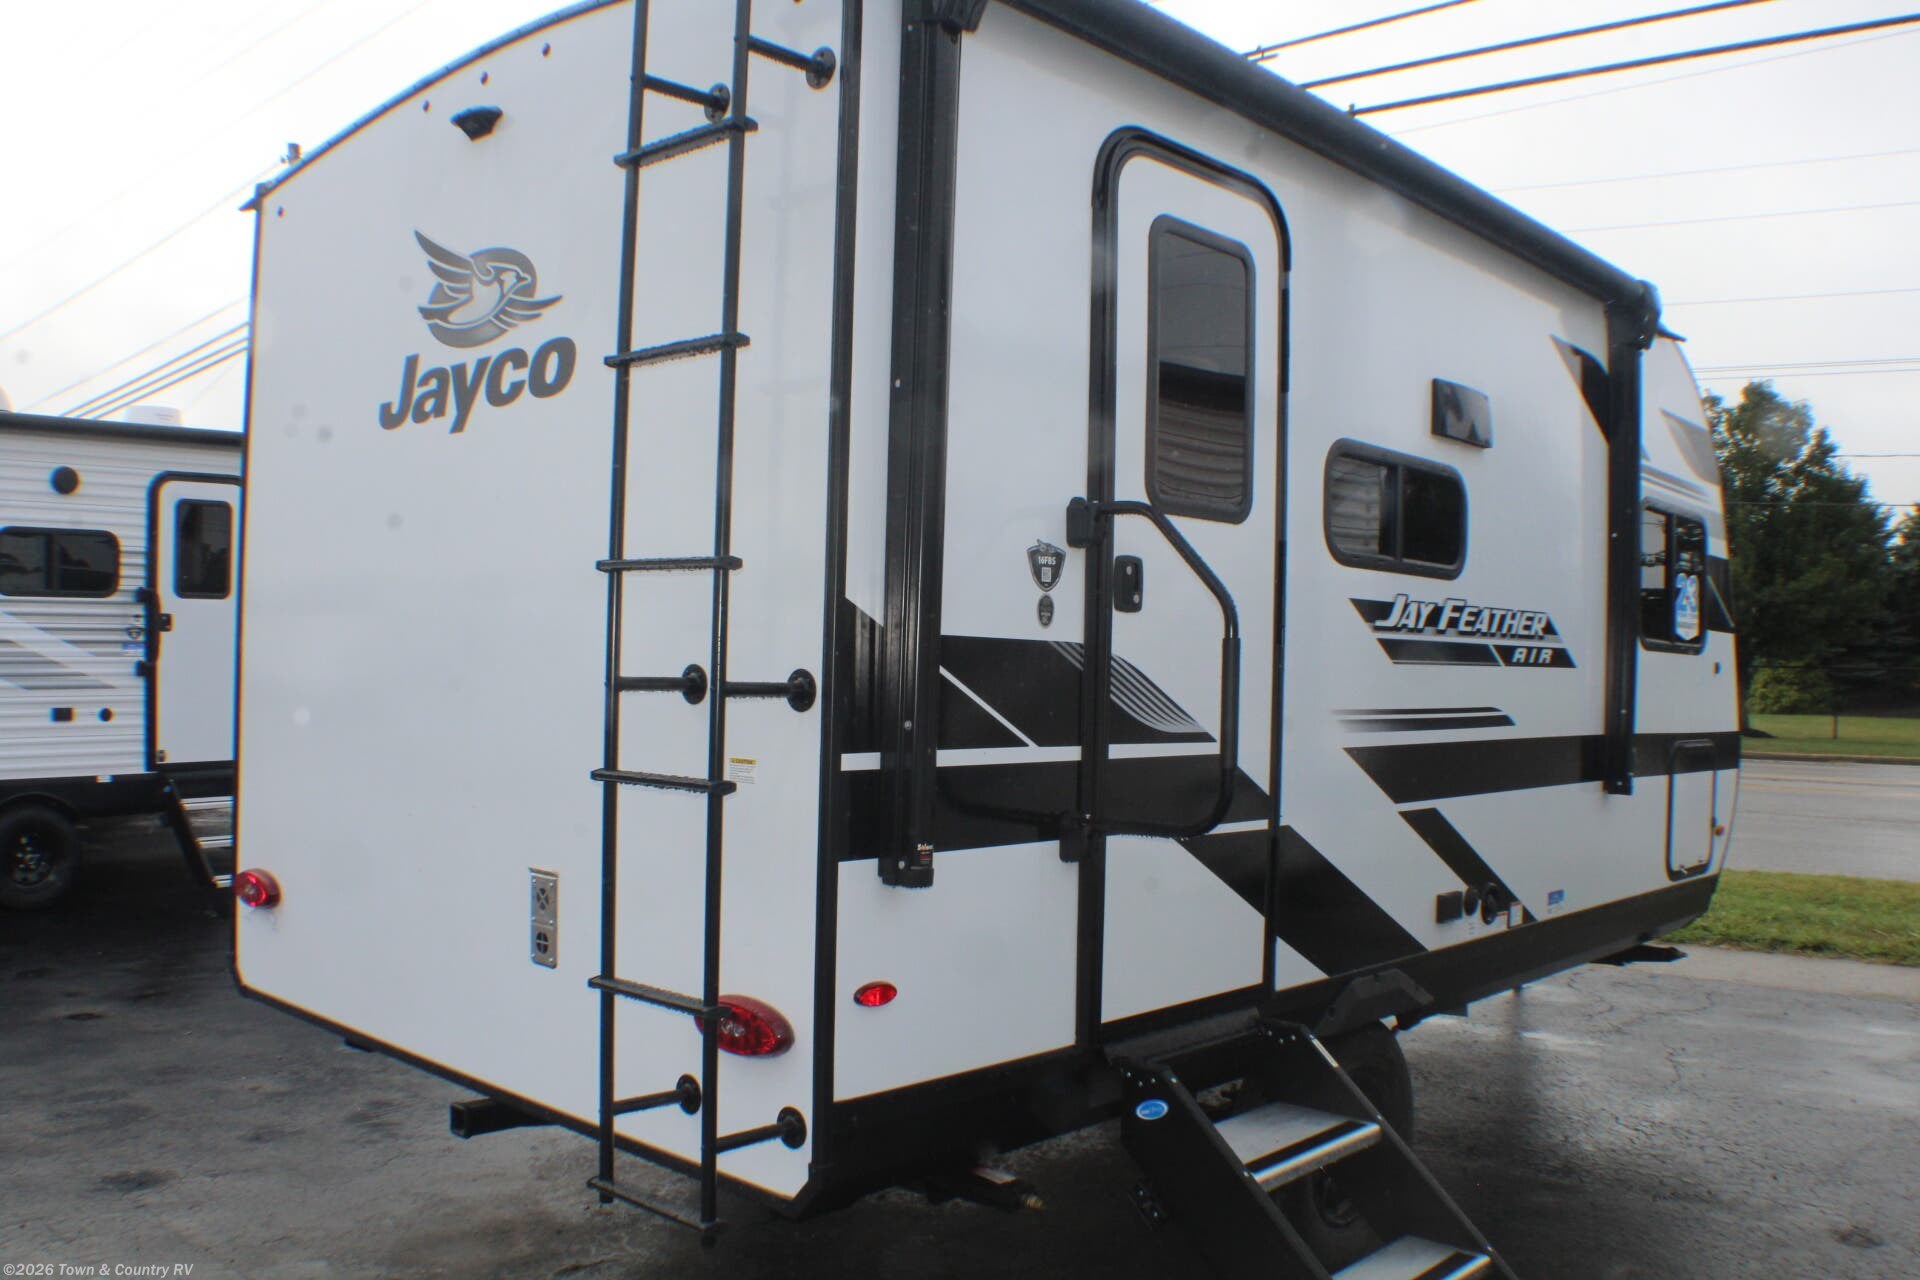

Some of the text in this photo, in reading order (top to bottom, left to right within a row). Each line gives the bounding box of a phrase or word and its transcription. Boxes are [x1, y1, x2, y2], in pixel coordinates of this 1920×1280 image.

[379, 336, 577, 434] Jayco
[1372, 593, 1549, 638] JAY FEATHER
[1511, 648, 1554, 664] AIR
